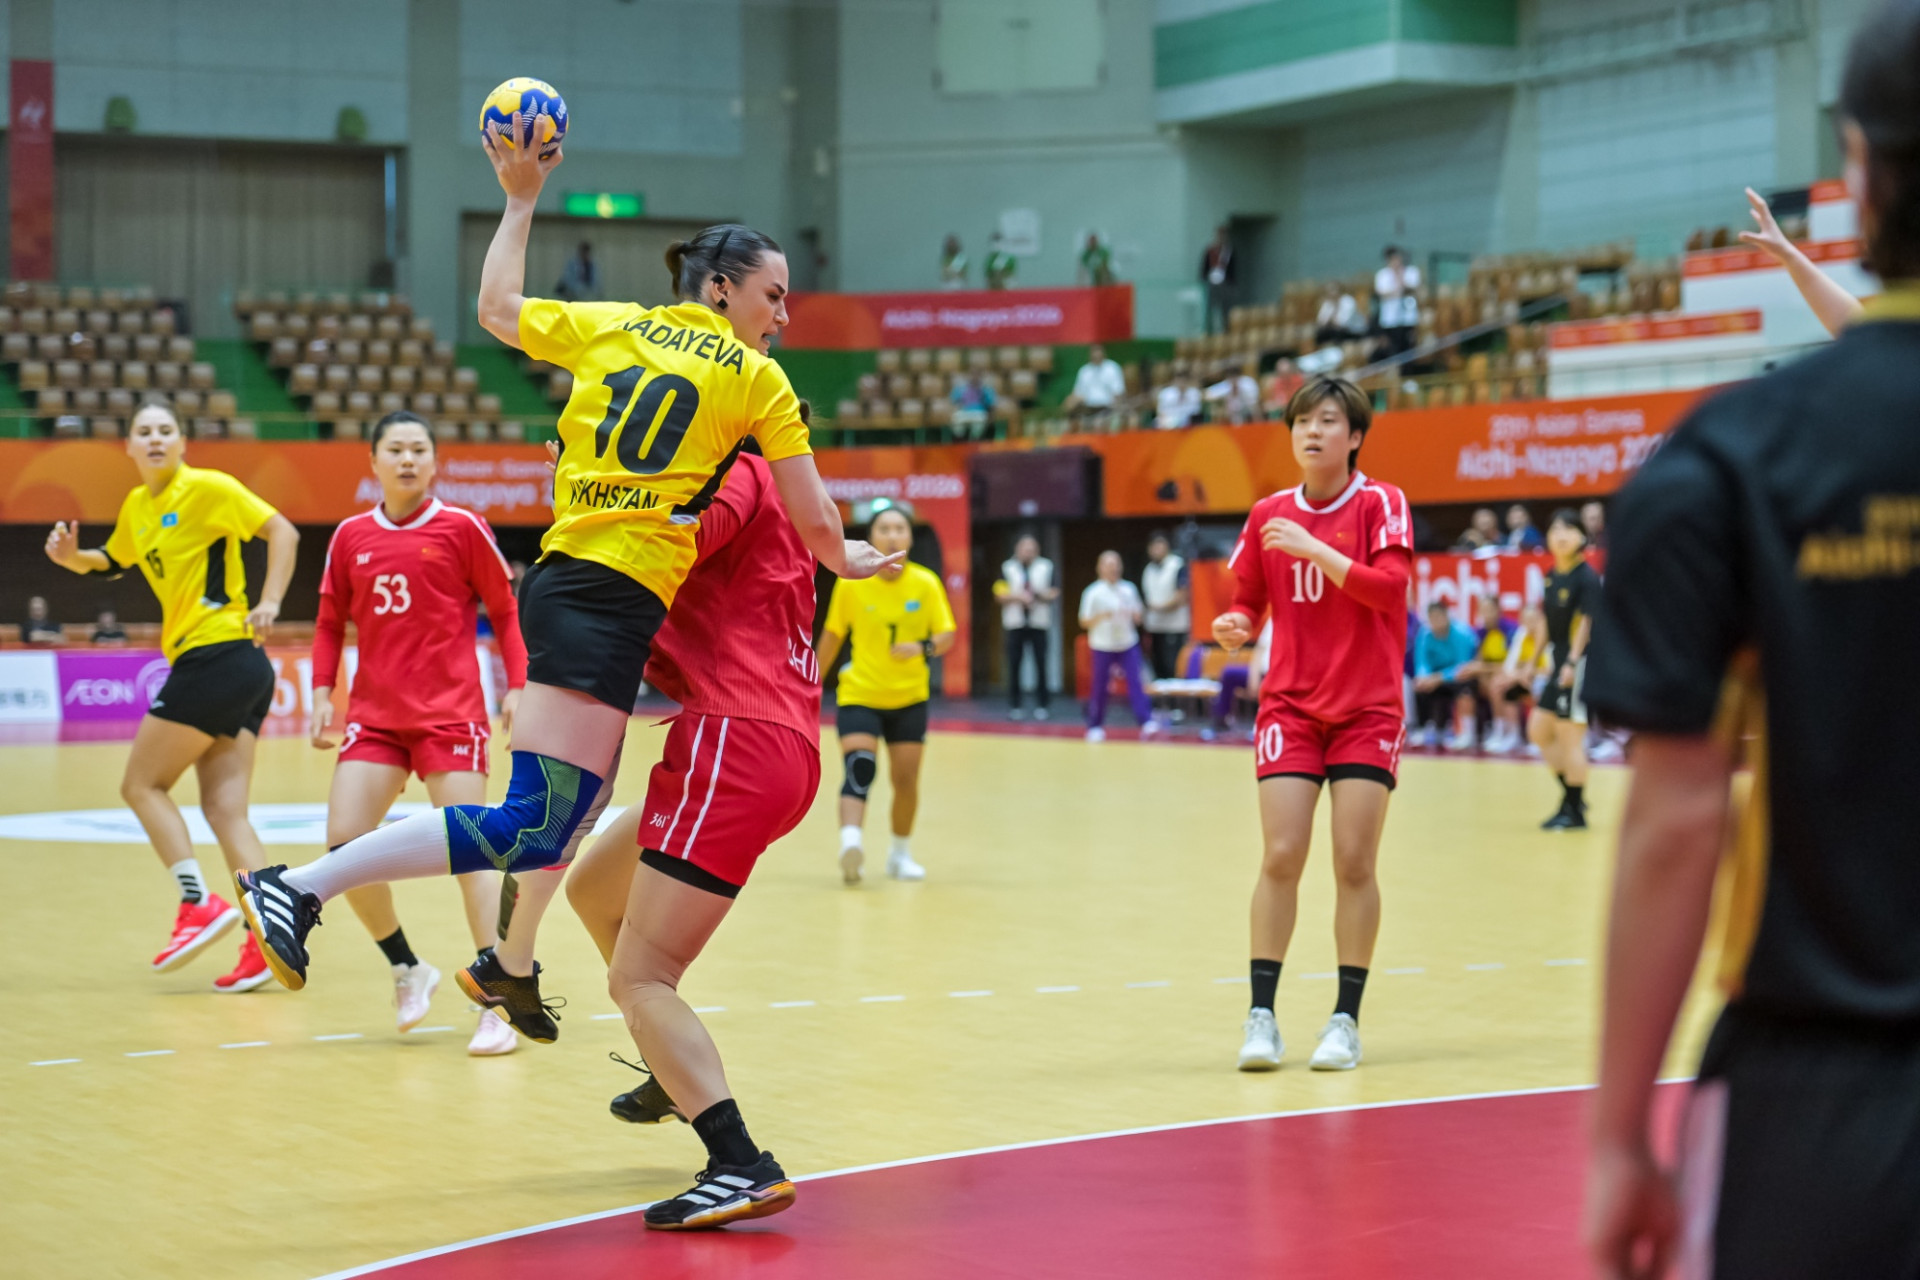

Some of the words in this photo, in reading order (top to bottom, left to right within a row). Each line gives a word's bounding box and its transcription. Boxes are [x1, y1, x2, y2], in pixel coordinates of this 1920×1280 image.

[594, 364, 700, 475] 10
[569, 478, 660, 510] KHSTAN
[372, 573, 412, 615] 53
[1290, 560, 1324, 603] 10
[1257, 722, 1284, 766] 10
